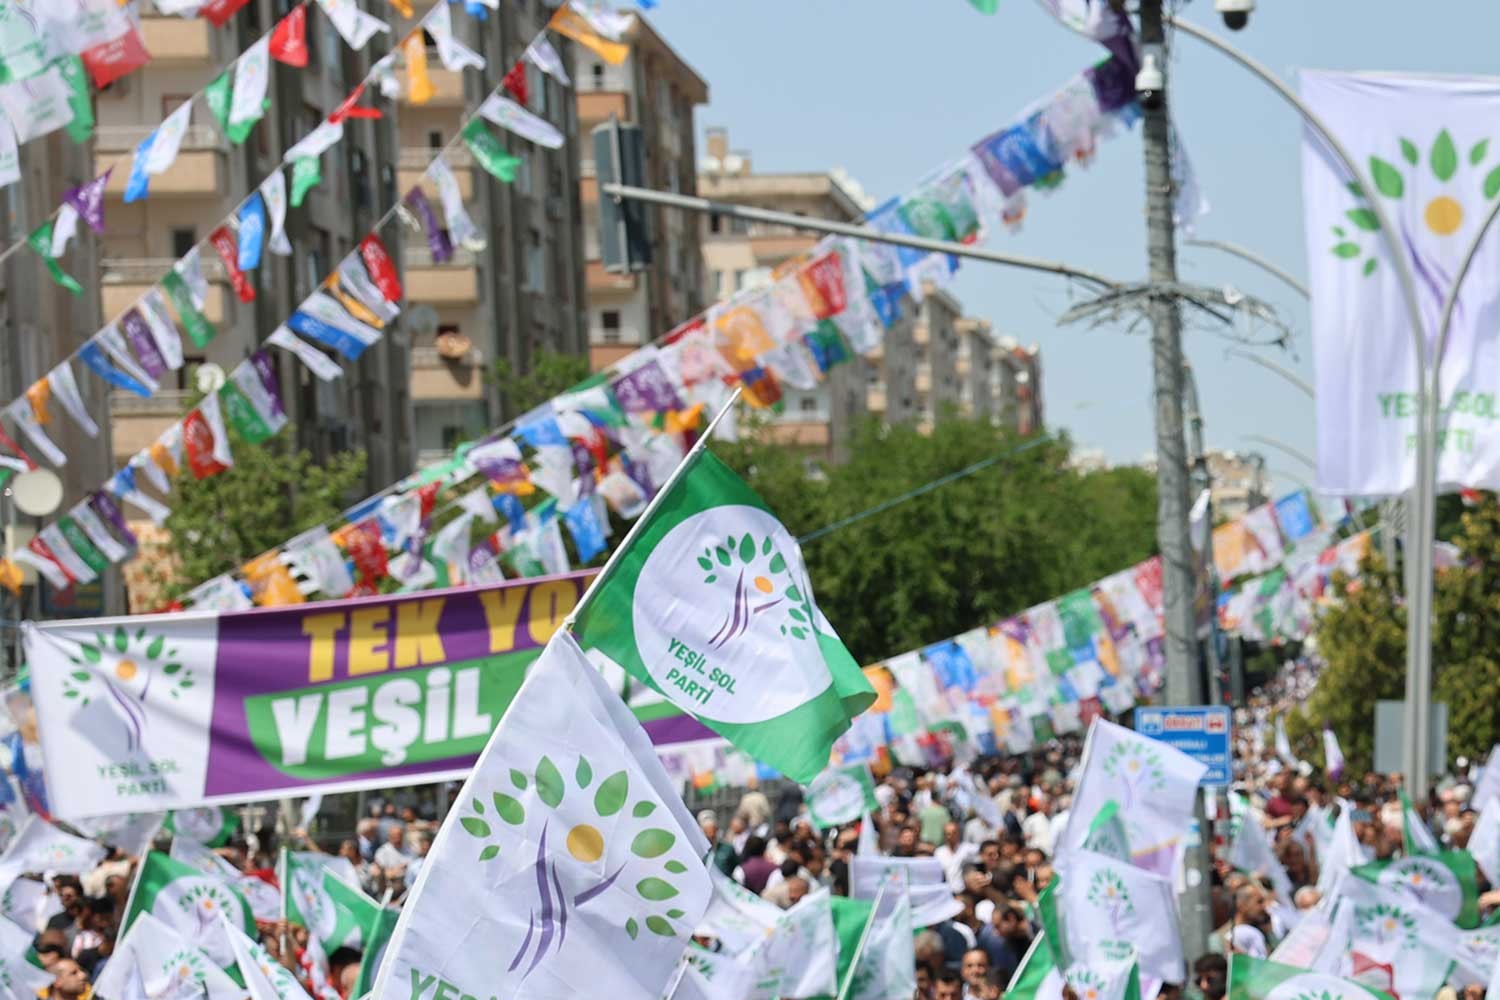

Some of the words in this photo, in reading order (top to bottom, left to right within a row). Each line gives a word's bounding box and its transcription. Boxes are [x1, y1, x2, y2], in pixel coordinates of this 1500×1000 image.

[302, 598, 446, 683] TEK
[479, 575, 594, 653] YO
[668, 637, 706, 675] YEŞİL
[709, 667, 736, 695] SOL
[271, 667, 491, 767] YEŞİL
